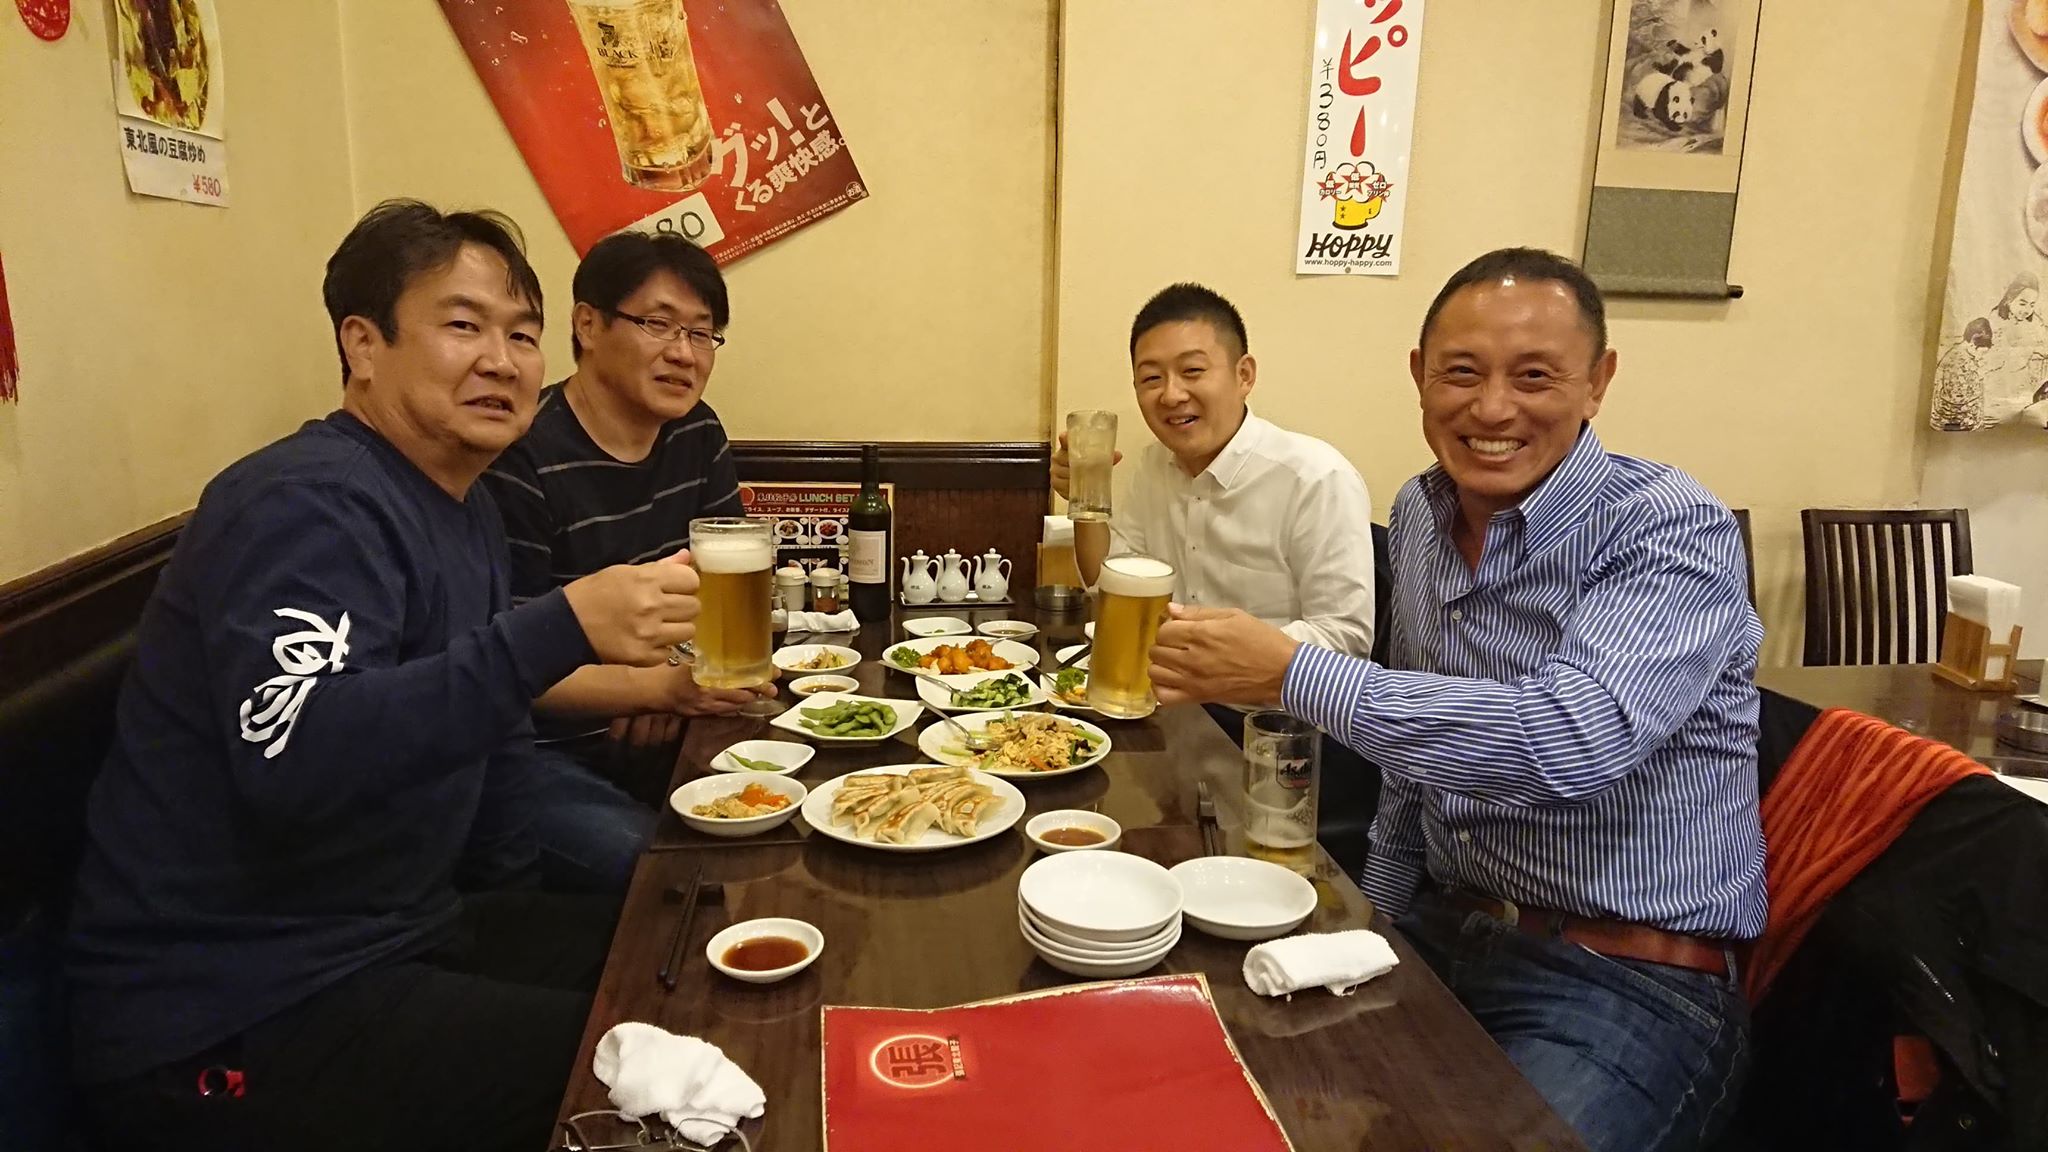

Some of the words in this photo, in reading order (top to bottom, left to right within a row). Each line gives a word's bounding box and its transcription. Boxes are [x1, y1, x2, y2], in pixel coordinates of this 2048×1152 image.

[123, 126, 206, 164] 東北風の豆腐炒め
[735, 129, 846, 212] くる爽快感。
[192, 172, 221, 197] ¥580
[1304, 259, 1392, 268] www.hoppy-happy.com
[799, 494, 833, 502] LUNCH
[835, 494, 855, 503] SET
